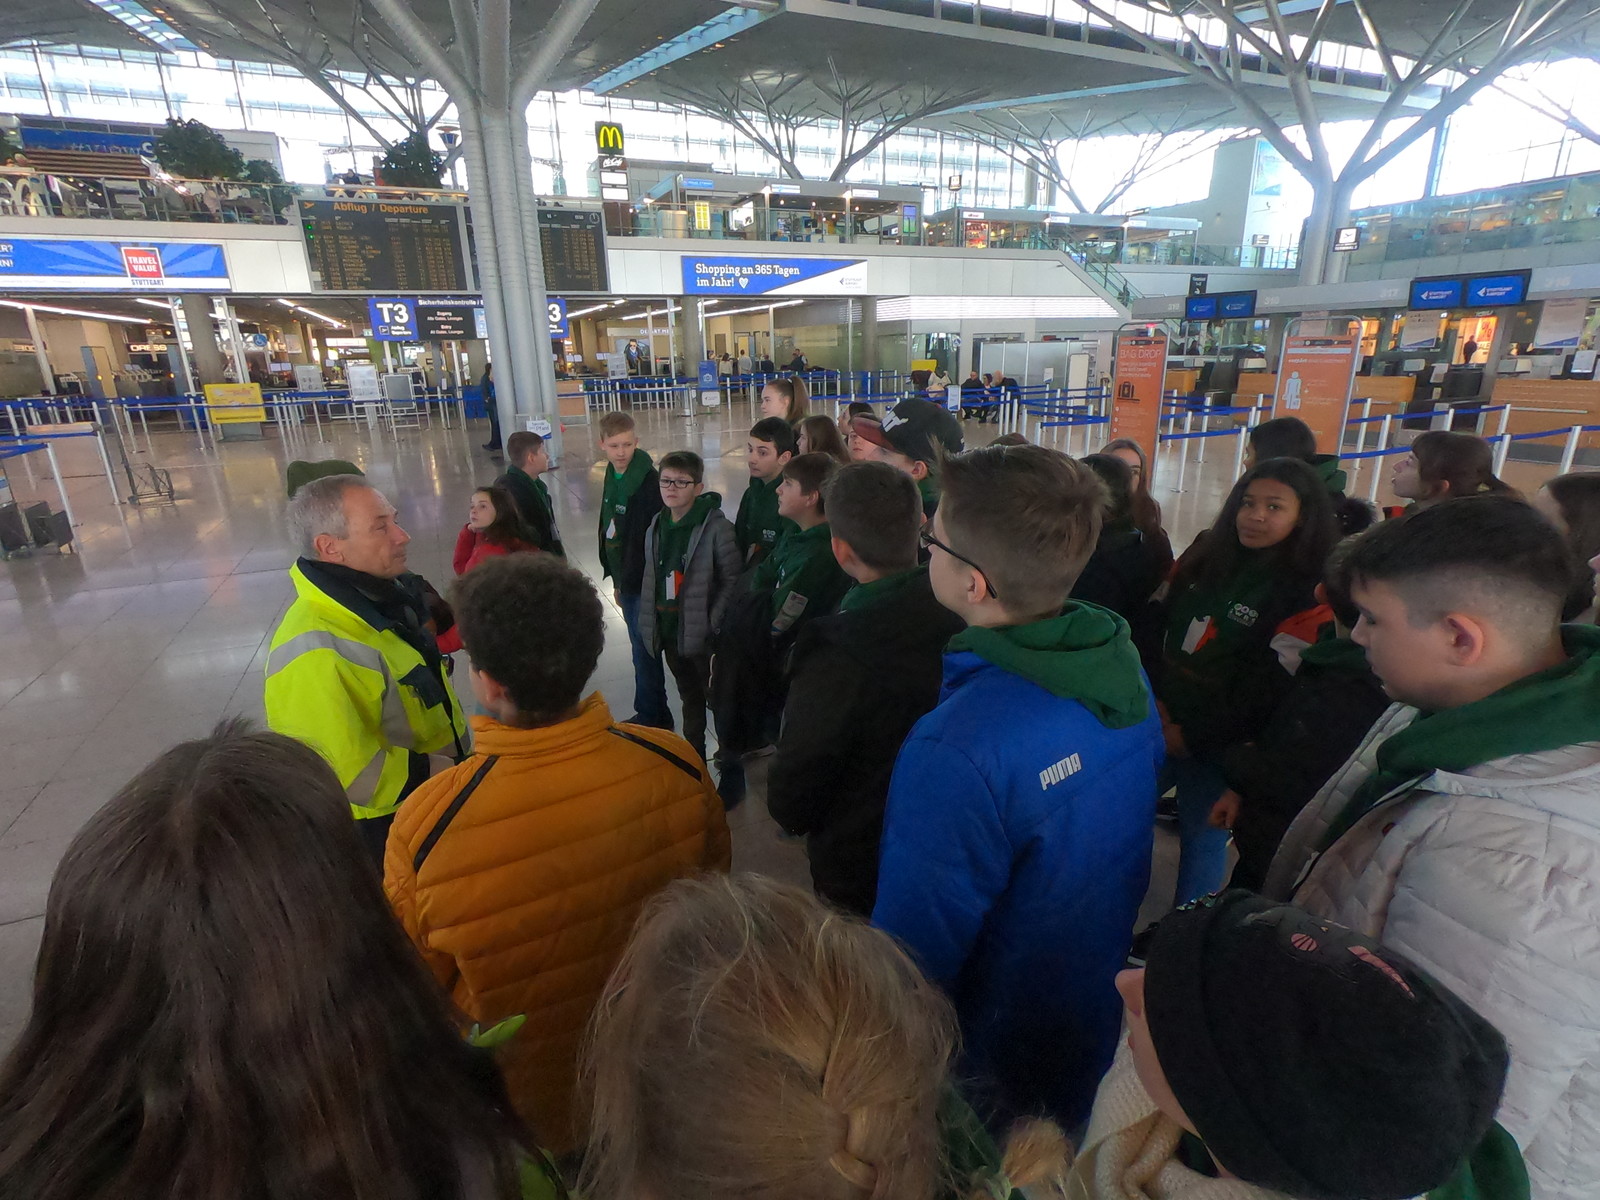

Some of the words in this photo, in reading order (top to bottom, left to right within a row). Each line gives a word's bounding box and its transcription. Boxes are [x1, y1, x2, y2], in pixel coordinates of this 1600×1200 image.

[333, 202, 368, 214] Abflug
[379, 203, 429, 215] Departure
[0, 244, 13, 253] R?
[127, 256, 157, 265] TRAVEL
[133, 264, 158, 272] VALUE
[695, 263, 740, 277] Shopping
[742, 266, 754, 274] an
[755, 264, 772, 275] 365
[774, 265, 800, 277] Tagen
[696, 277, 709, 287] im
[711, 277, 735, 287] Jahr!
[376, 303, 409, 323] T3
[1120, 349, 1136, 359] BAG
[1138, 348, 1162, 359] DROP
[1039, 752, 1082, 791] PUMA
